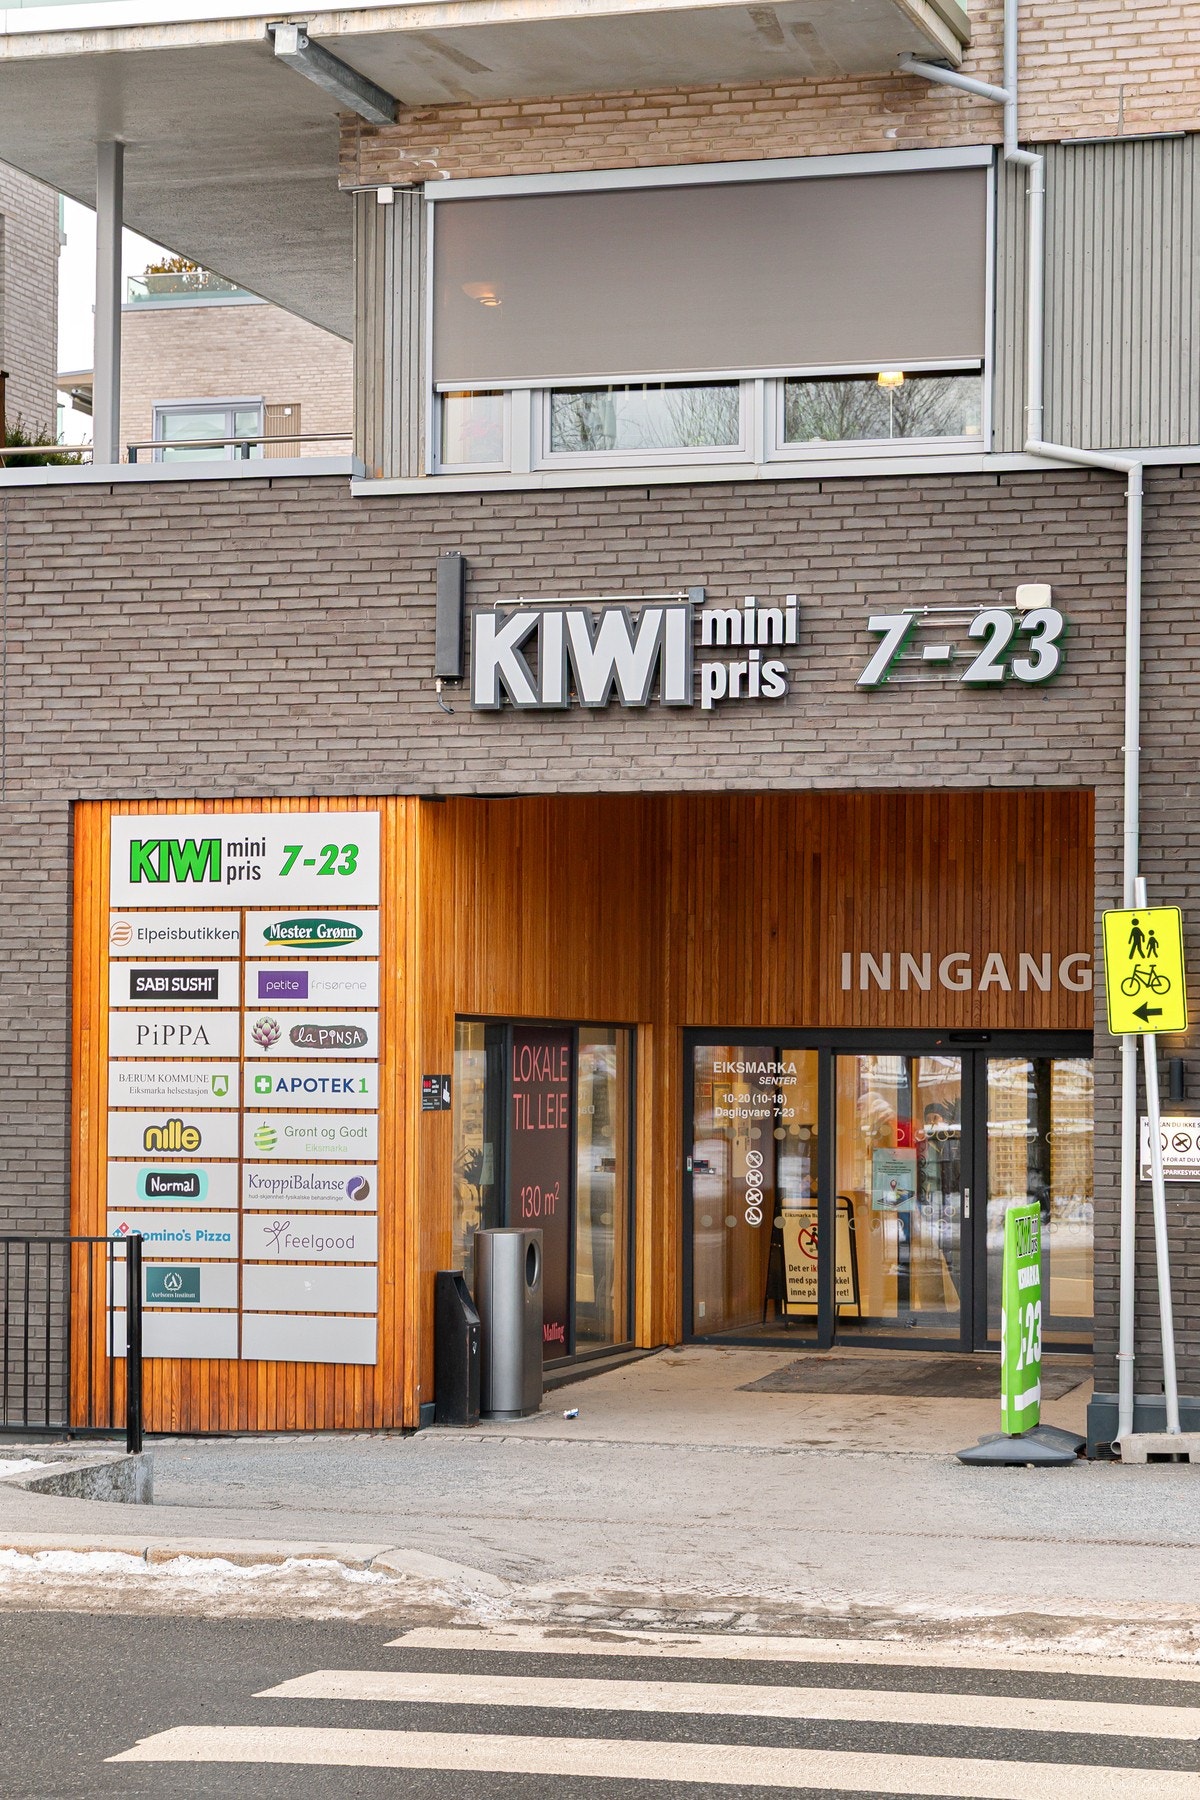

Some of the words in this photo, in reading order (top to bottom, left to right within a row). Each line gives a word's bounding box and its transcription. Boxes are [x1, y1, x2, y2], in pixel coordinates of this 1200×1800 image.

[702, 595, 800, 646] mini
[856, 608, 1068, 689] 7-23
[472, 604, 693, 709] KIWI
[702, 649, 788, 710] pris
[227, 837, 266, 857] mini
[130, 838, 222, 883] KIWI
[279, 844, 359, 876] 7-23
[227, 861, 261, 884] pris
[137, 927, 240, 943] Elpeisbutikken
[269, 924, 314, 939] Mester
[316, 924, 357, 938] Grønn
[841, 952, 1092, 992] INNGANG
[136, 978, 168, 991] SABI
[172, 978, 212, 991] SUSHI
[266, 980, 299, 992] petite
[311, 980, 367, 990] frisørene
[136, 1024, 210, 1045] PiPPA
[295, 1028, 316, 1043] la
[512, 1046, 568, 1082] LOKALE
[713, 1062, 797, 1074] EIKSMARKA
[119, 1074, 155, 1082] BÆRUM
[158, 1074, 209, 1083] KOMMUNE
[276, 1078, 355, 1093] APOTEK
[359, 1078, 368, 1093] 1
[759, 1076, 797, 1085] SENTER
[129, 1086, 166, 1094] Eiksmarka
[167, 1087, 208, 1096] helsestasjon
[722, 1094, 750, 1104] 10-20
[752, 1094, 787, 1105] (10-18)
[512, 1094, 534, 1130] TIL
[538, 1092, 568, 1130] LEIE
[715, 1107, 772, 1119] Dagligvare
[774, 1108, 794, 1118] 7-23
[144, 1118, 202, 1151] nille
[284, 1126, 318, 1138] Grønt
[321, 1128, 336, 1141] og
[340, 1126, 368, 1138] Godt
[305, 1143, 348, 1152] Eiksmarka
[151, 1177, 194, 1192] Normal
[248, 1174, 344, 1194] KroppiBalanse
[520, 1186, 541, 1218] 130
[196, 1230, 230, 1242] Pizza
[285, 1234, 354, 1252] feelgood
[788, 1264, 800, 1272] Det
